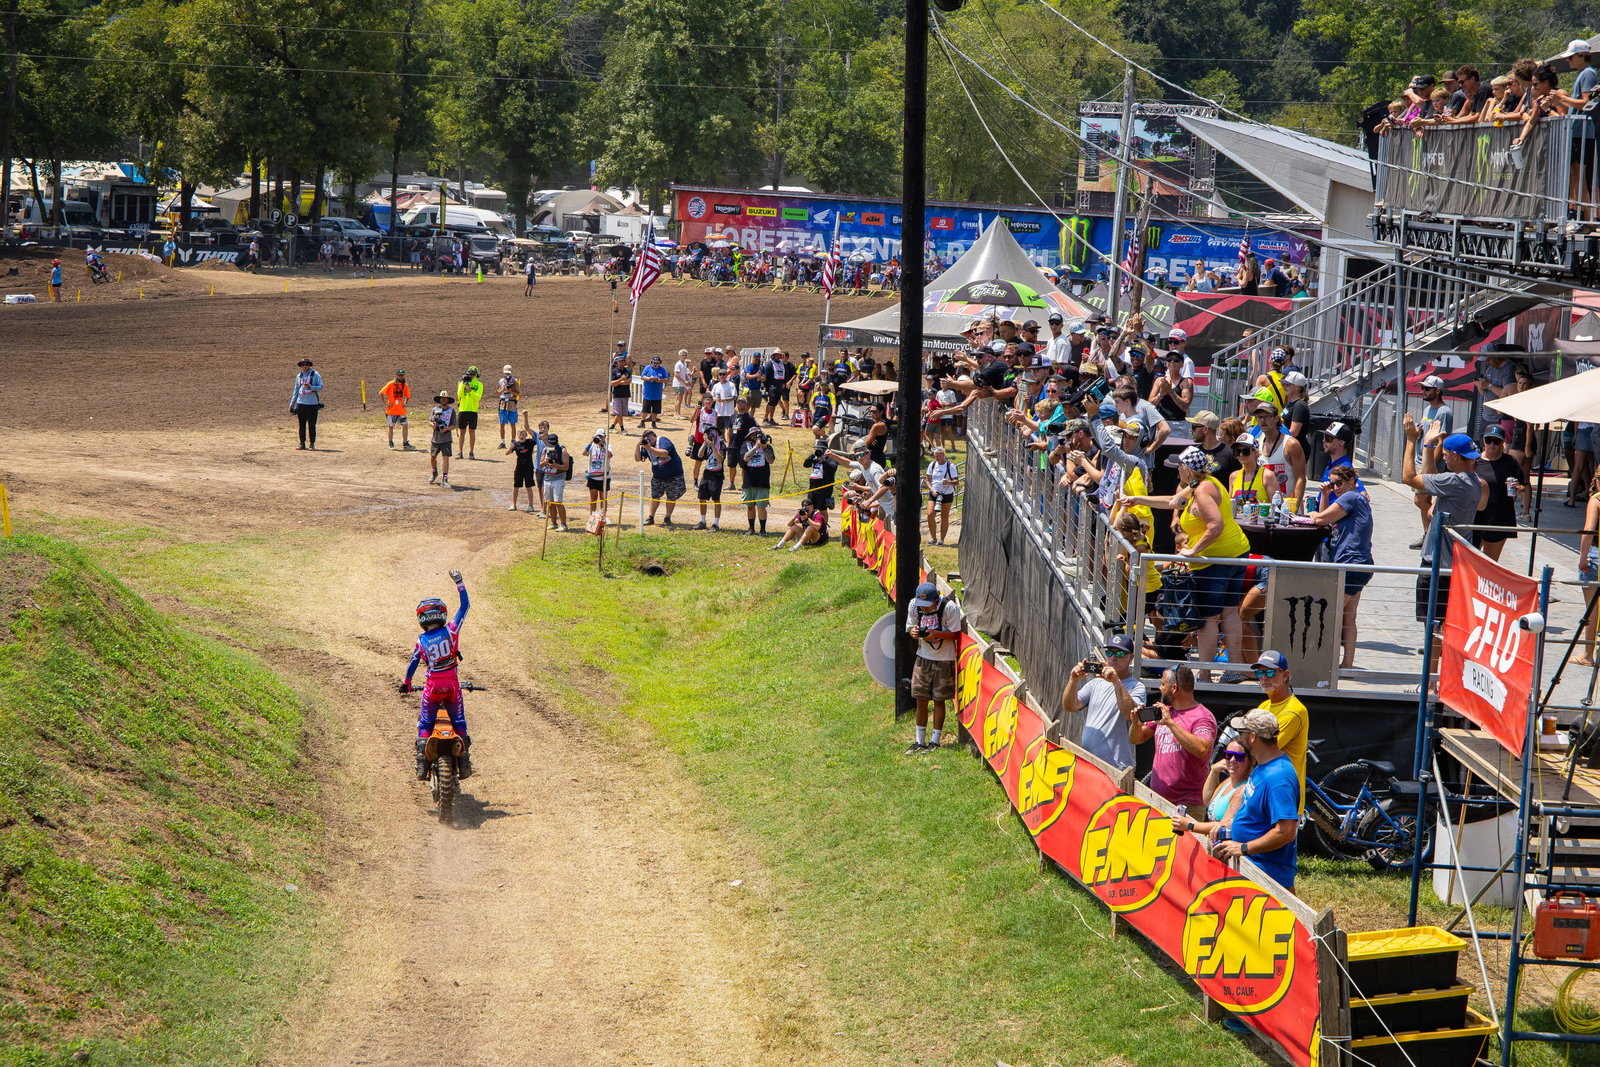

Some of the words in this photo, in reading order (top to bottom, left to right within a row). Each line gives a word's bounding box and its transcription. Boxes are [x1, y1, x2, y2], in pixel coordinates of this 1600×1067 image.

[273, 211, 280, 221] P
[287, 214, 295, 225] P
[1010, 222, 1040, 230] MONSTER
[706, 225, 829, 257] LORETTA
[1168, 234, 1202, 243] AMSOIL
[1258, 239, 1289, 247] PARTS
[196, 250, 239, 263] THOR
[1477, 575, 1505, 603] WATCH
[1506, 592, 1518, 611] ON
[428, 639, 451, 661] 30
[1472, 667, 1495, 699] RACING
[1019, 742, 1077, 817] FMF
[1081, 806, 1180, 887] FMF
[1119, 888, 1138, 898] CALIF.
[1184, 894, 1297, 979] FMF
[1235, 986, 1257, 997] CALIF.
